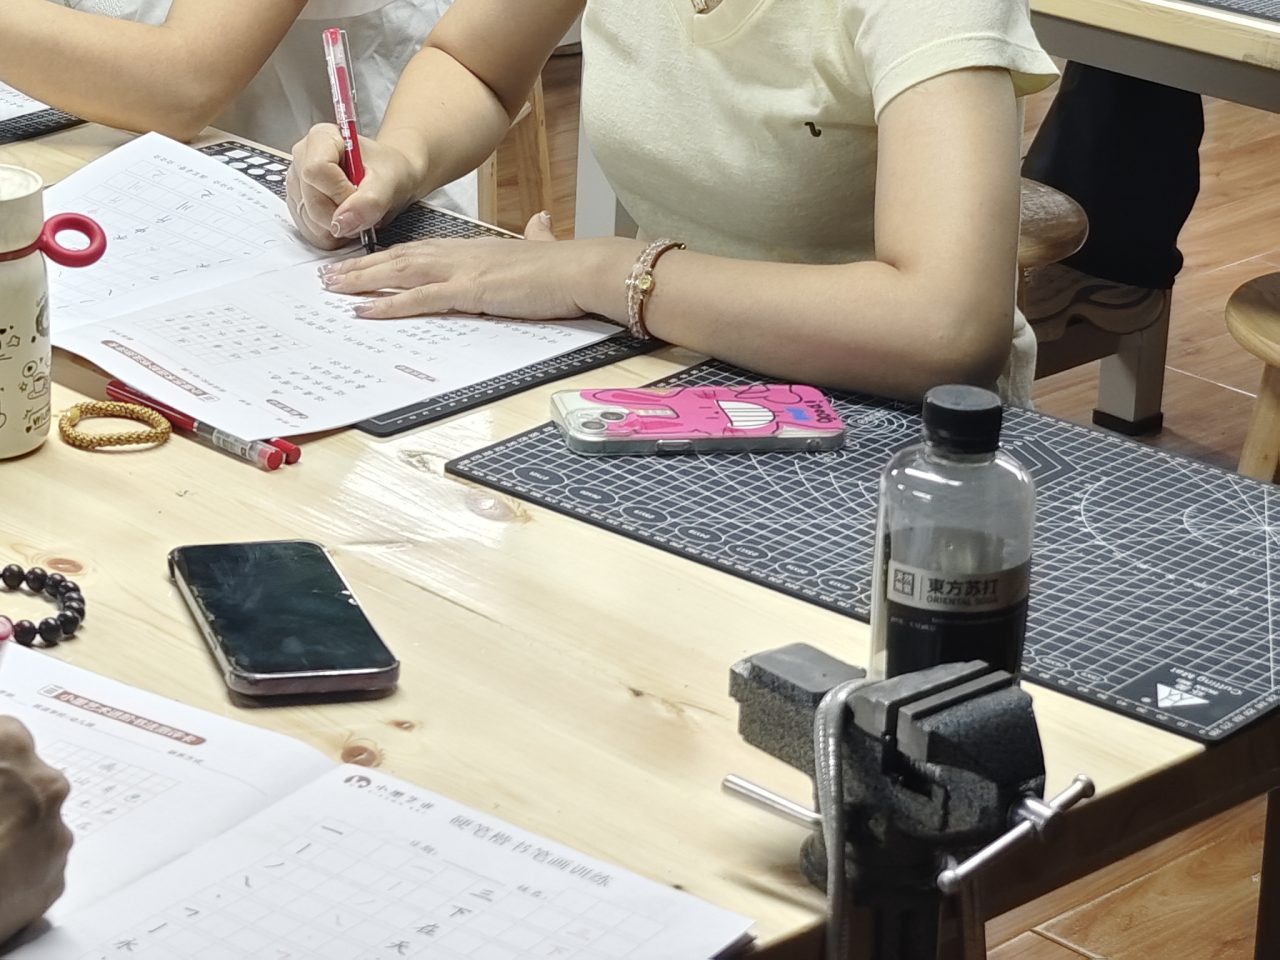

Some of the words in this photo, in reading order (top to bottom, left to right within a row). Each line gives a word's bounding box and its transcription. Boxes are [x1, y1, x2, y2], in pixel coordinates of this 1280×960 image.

[927, 577, 1000, 596] 東方苏打
[926, 594, 972, 606] ORIENTAL
[1169, 666, 1196, 680] Mat
[1197, 672, 1244, 696] Cutting
